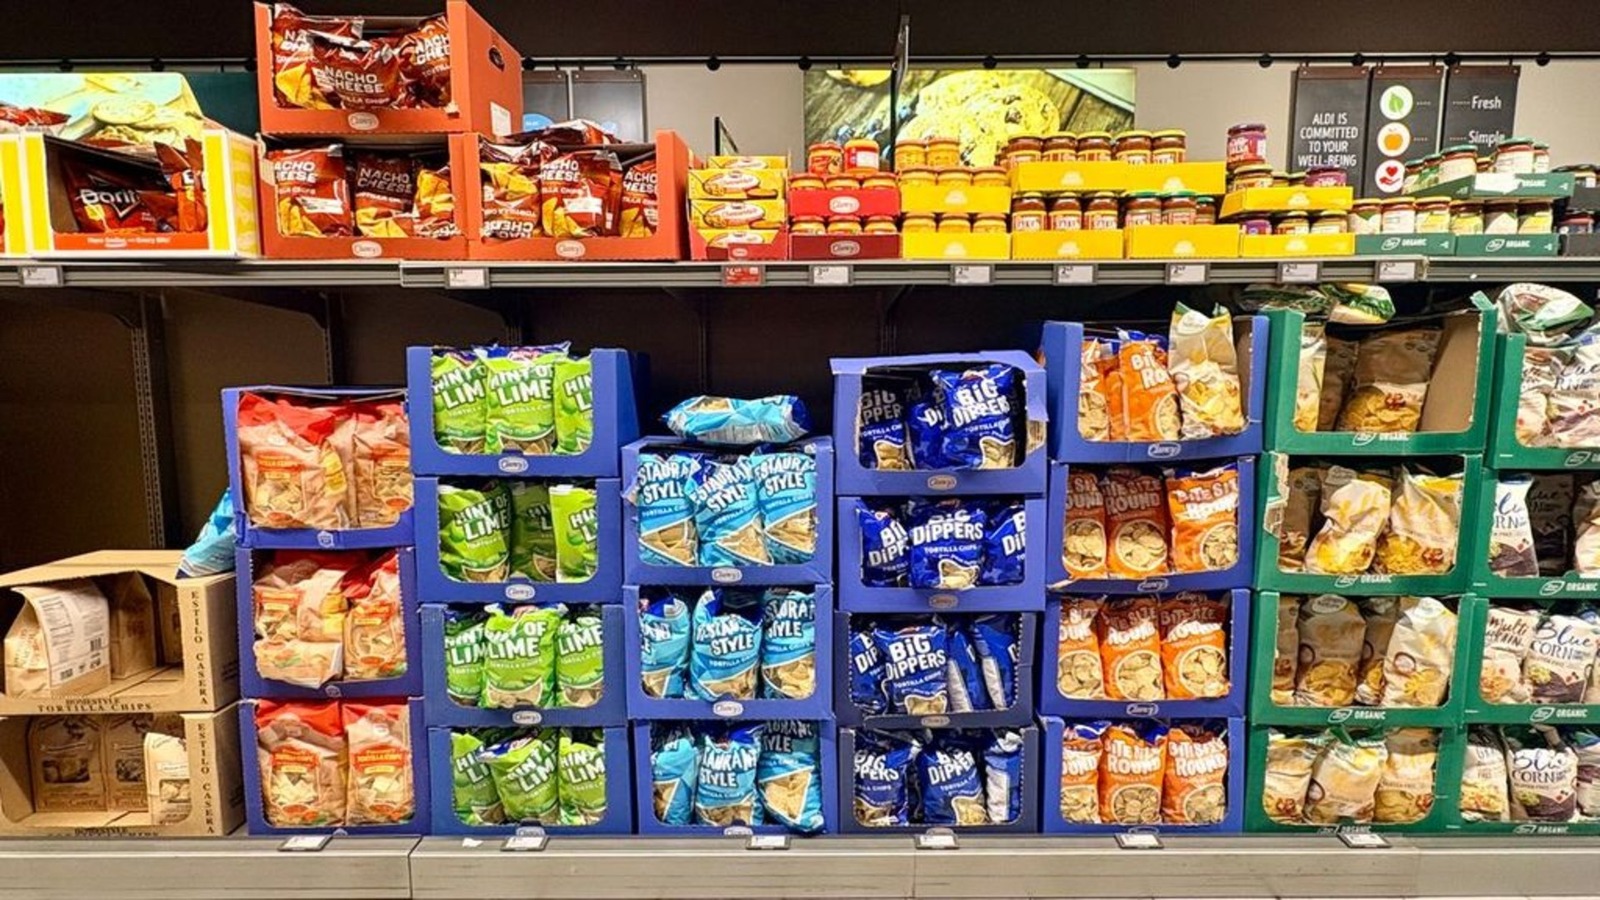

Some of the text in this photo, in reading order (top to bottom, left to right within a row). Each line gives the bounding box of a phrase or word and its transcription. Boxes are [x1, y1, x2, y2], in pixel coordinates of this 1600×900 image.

[1471, 96, 1501, 109] Fresh
[1312, 112, 1347, 125] ALDI IS
[1300, 127, 1358, 139] COMMITTED
[1309, 141, 1348, 153] TO YOUR
[1298, 154, 1357, 167] WELL-BEING
[359, 168, 410, 183] NACHO
[357, 178, 412, 193] CHEESE
[441, 379, 485, 409] LIM
[496, 379, 553, 407] LIME
[764, 472, 805, 495] STYLE
[1106, 493, 1161, 515] ROUND
[463, 508, 511, 541] LIME
[1566, 583, 1598, 591] ORGANIC
[524, 621, 548, 636] OF
[490, 638, 540, 659] LIME
[711, 634, 754, 656] STYLE
[1531, 641, 1574, 659] CORN
[37, 704, 152, 713] TORTILLA CHIPS
[1354, 711, 1386, 720] ORGANIC
[1556, 709, 1588, 717] ORGANIC
[567, 757, 605, 784] LIM
[1108, 757, 1162, 774] ROUND
[1175, 753, 1227, 777] ROUND
[519, 754, 556, 793] LIM
[1512, 770, 1555, 783] CORN
[202, 783, 214, 834] CASERA
